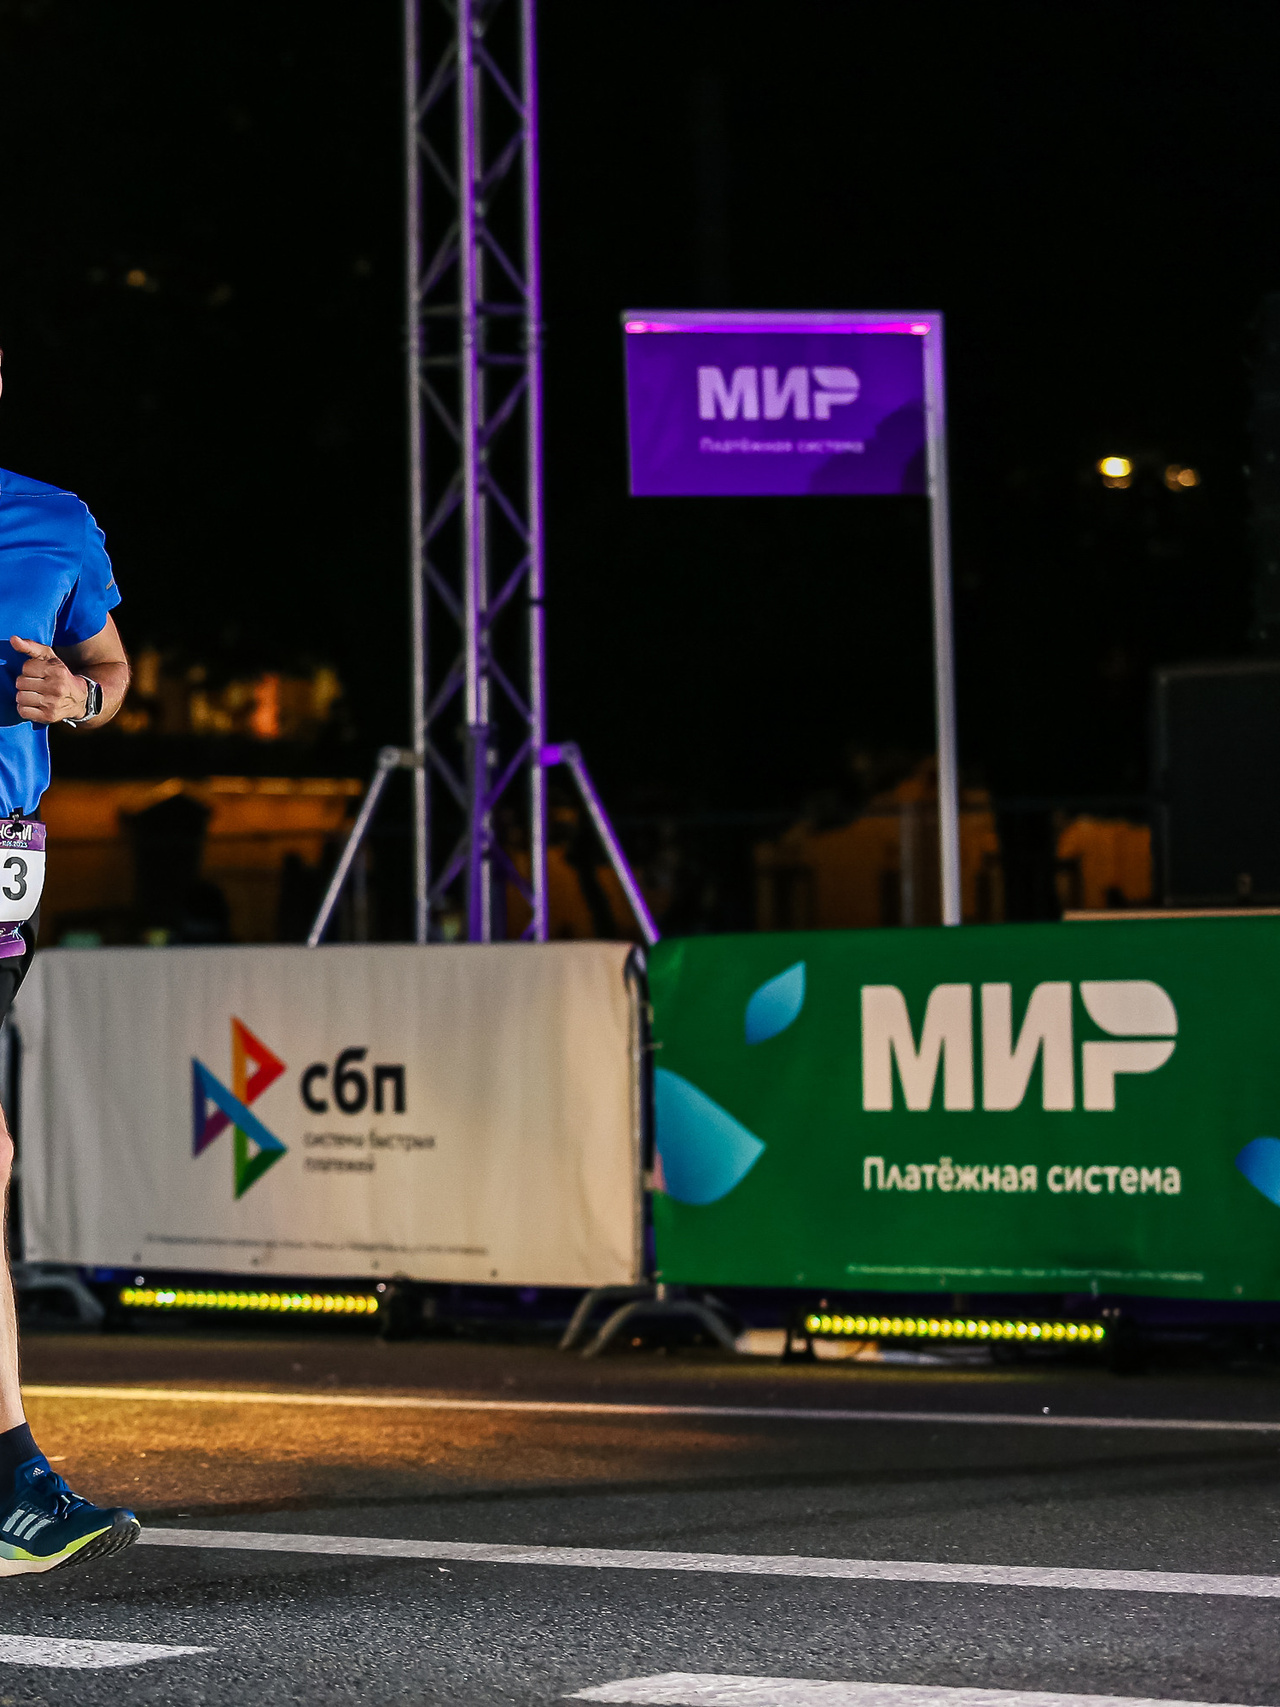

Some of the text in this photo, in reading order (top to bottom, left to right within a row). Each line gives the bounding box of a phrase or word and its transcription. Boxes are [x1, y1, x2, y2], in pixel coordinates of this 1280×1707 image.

[698, 366, 860, 420] МИР
[861, 980, 1178, 1111] МИР
[300, 1046, 407, 1115] сбп
[863, 1156, 1181, 1195] Платёжная система
